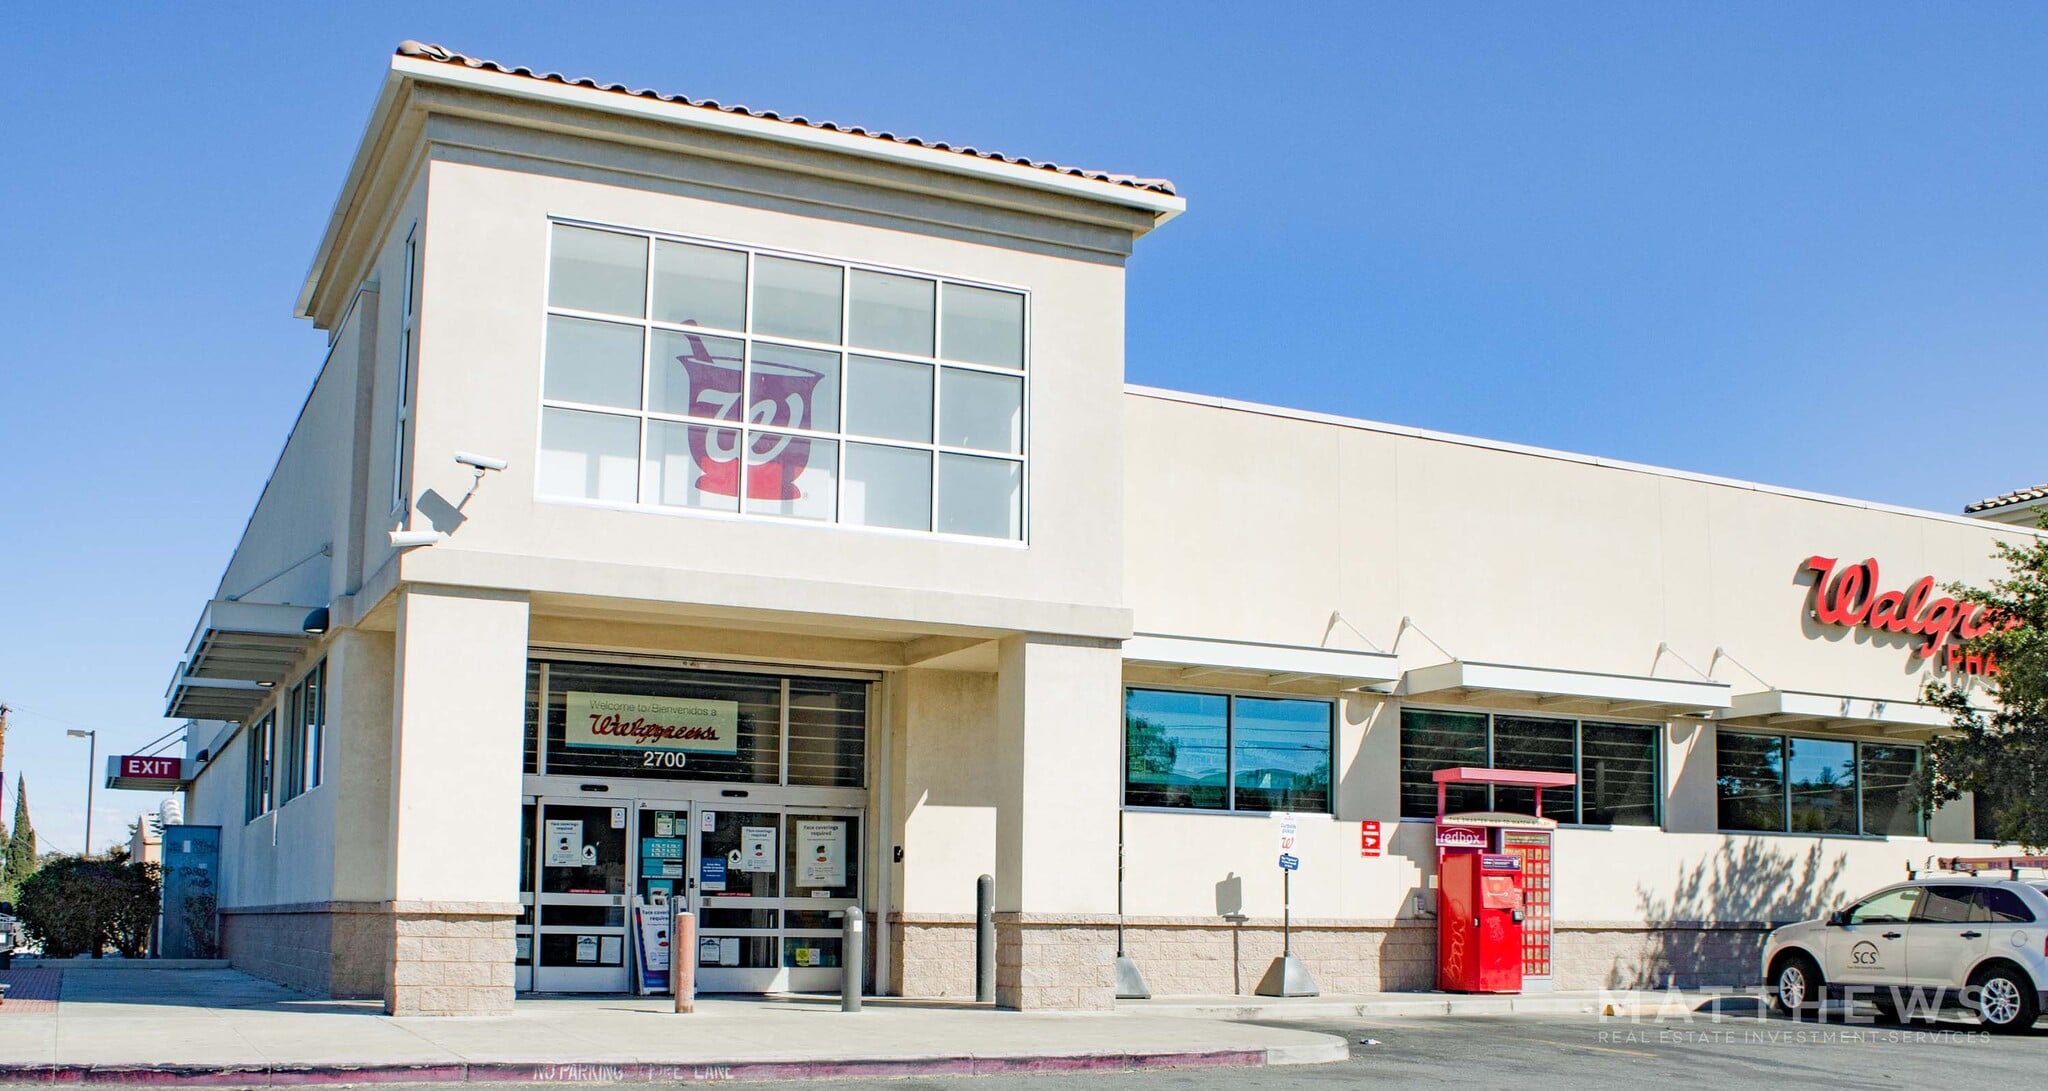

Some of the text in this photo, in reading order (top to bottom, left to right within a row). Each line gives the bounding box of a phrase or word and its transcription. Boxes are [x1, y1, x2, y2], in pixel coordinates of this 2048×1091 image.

[1807, 555, 2025, 659] Walgr
[590, 700, 636, 712] Welcome
[589, 713, 720, 744] Walgreens
[129, 760, 172, 775] EXIT
[643, 751, 686, 768] 2700
[1440, 831, 1480, 844] redbox
[1852, 951, 1877, 964] SCS
[533, 1063, 555, 1080] NO
[559, 1063, 624, 1081] PARKING
[694, 1064, 735, 1080] LANE
